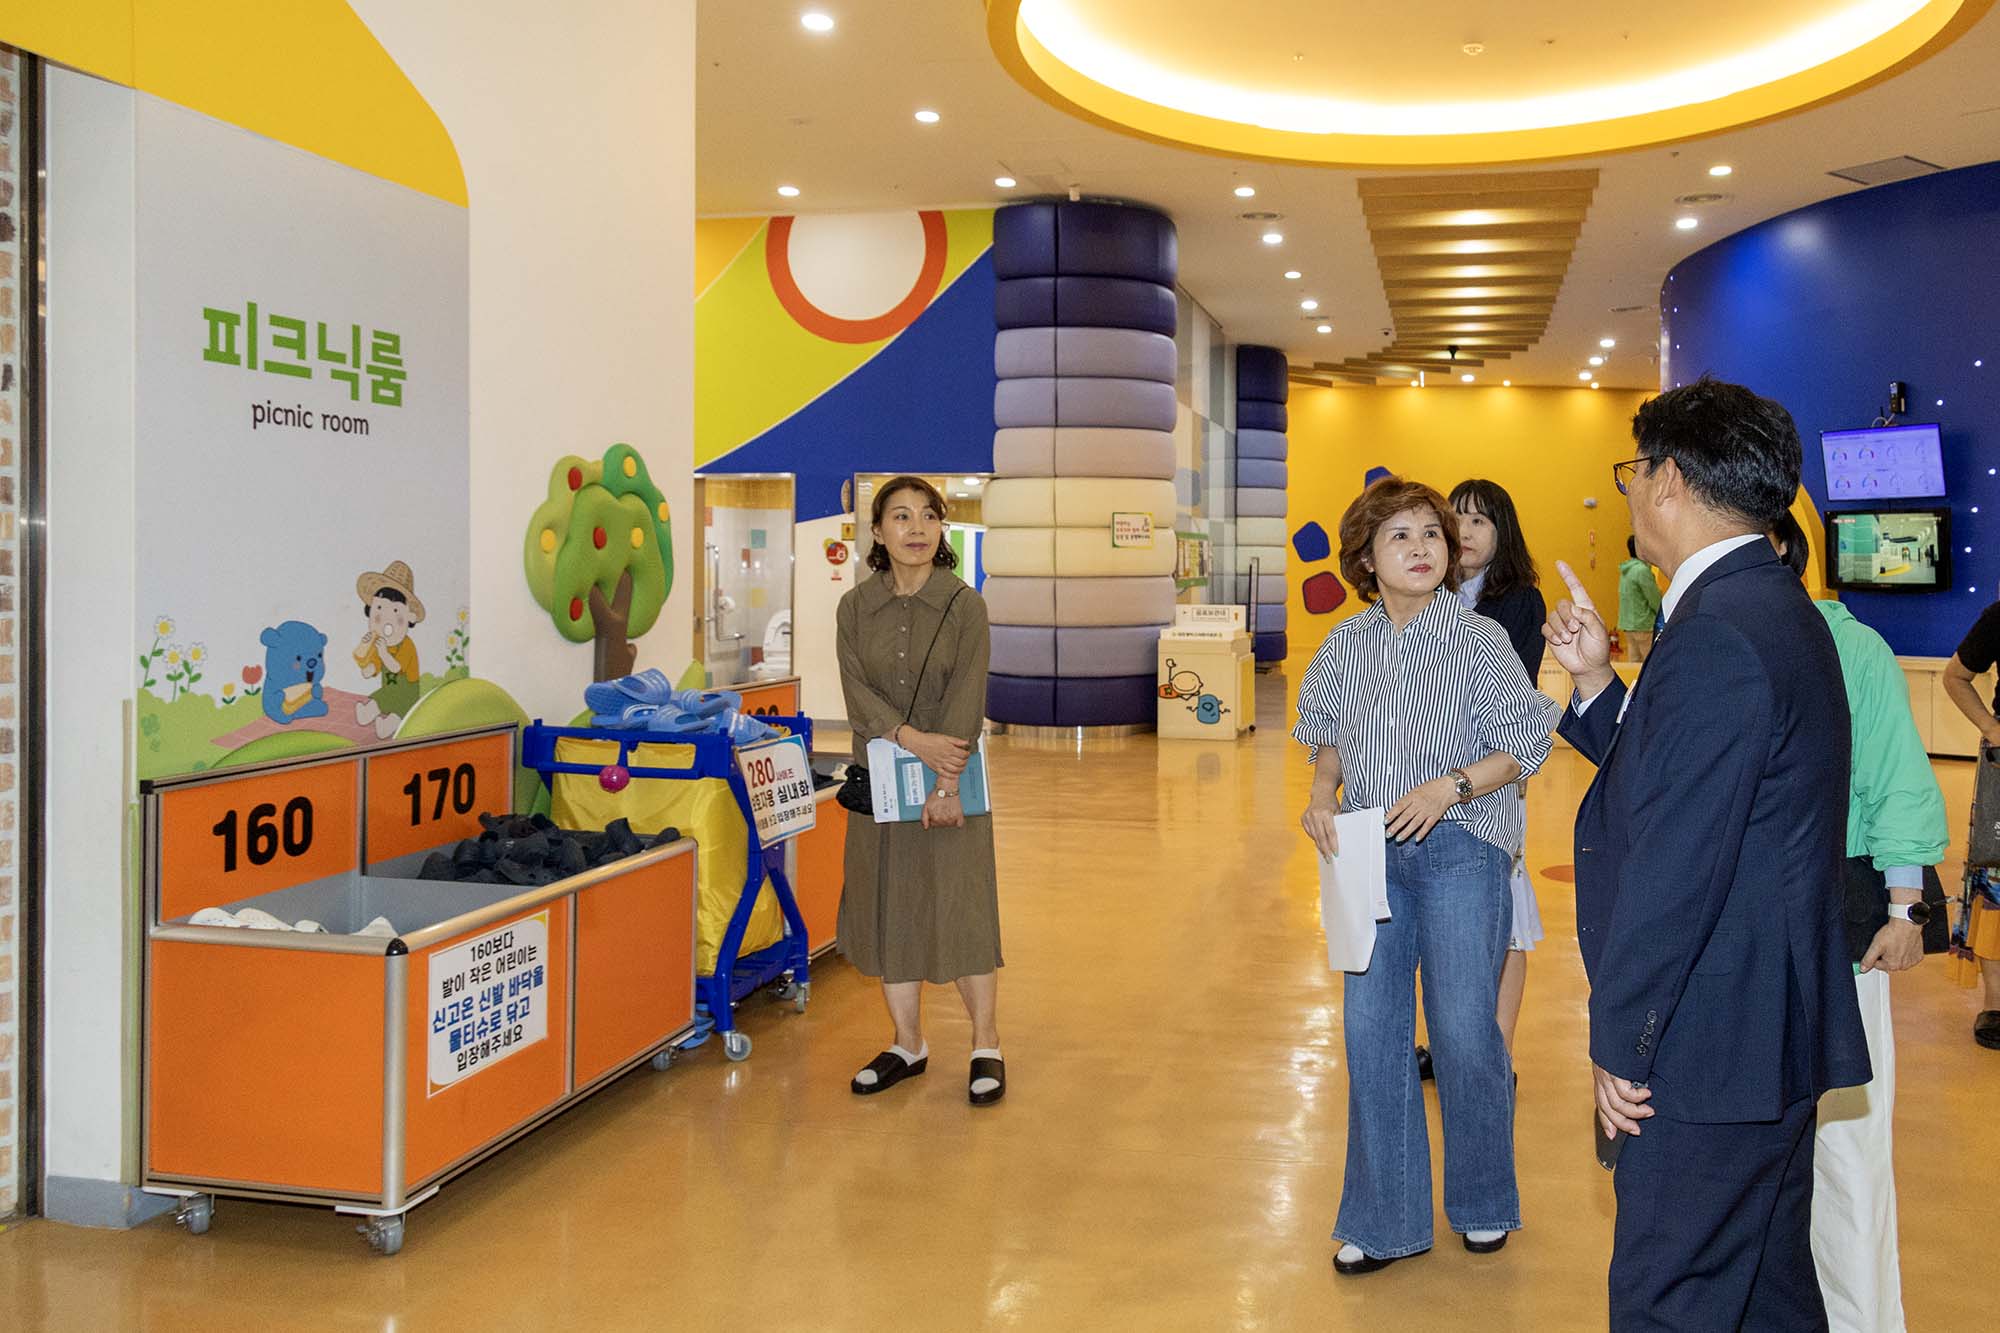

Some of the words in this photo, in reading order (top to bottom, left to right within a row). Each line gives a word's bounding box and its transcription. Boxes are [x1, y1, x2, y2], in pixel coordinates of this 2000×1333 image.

[203, 301, 407, 407] 피크닉룸
[252, 400, 313, 429] picnic
[321, 413, 369, 435] room
[403, 763, 475, 826] 170
[748, 757, 775, 789] 280
[777, 779, 809, 804] 실내화
[212, 796, 313, 873] 160
[442, 972, 465, 999] 발이
[469, 962, 492, 985] 작은
[496, 944, 537, 975] 어린이는
[470, 931, 514, 962] 160보다
[432, 996, 474, 1034] 신고온
[479, 983, 504, 1012] 신발
[509, 964, 544, 997] 바닥을
[449, 1010, 501, 1053] 물티슈로
[506, 996, 530, 1025] 닦고
[457, 1024, 523, 1072] 입장해주세요
